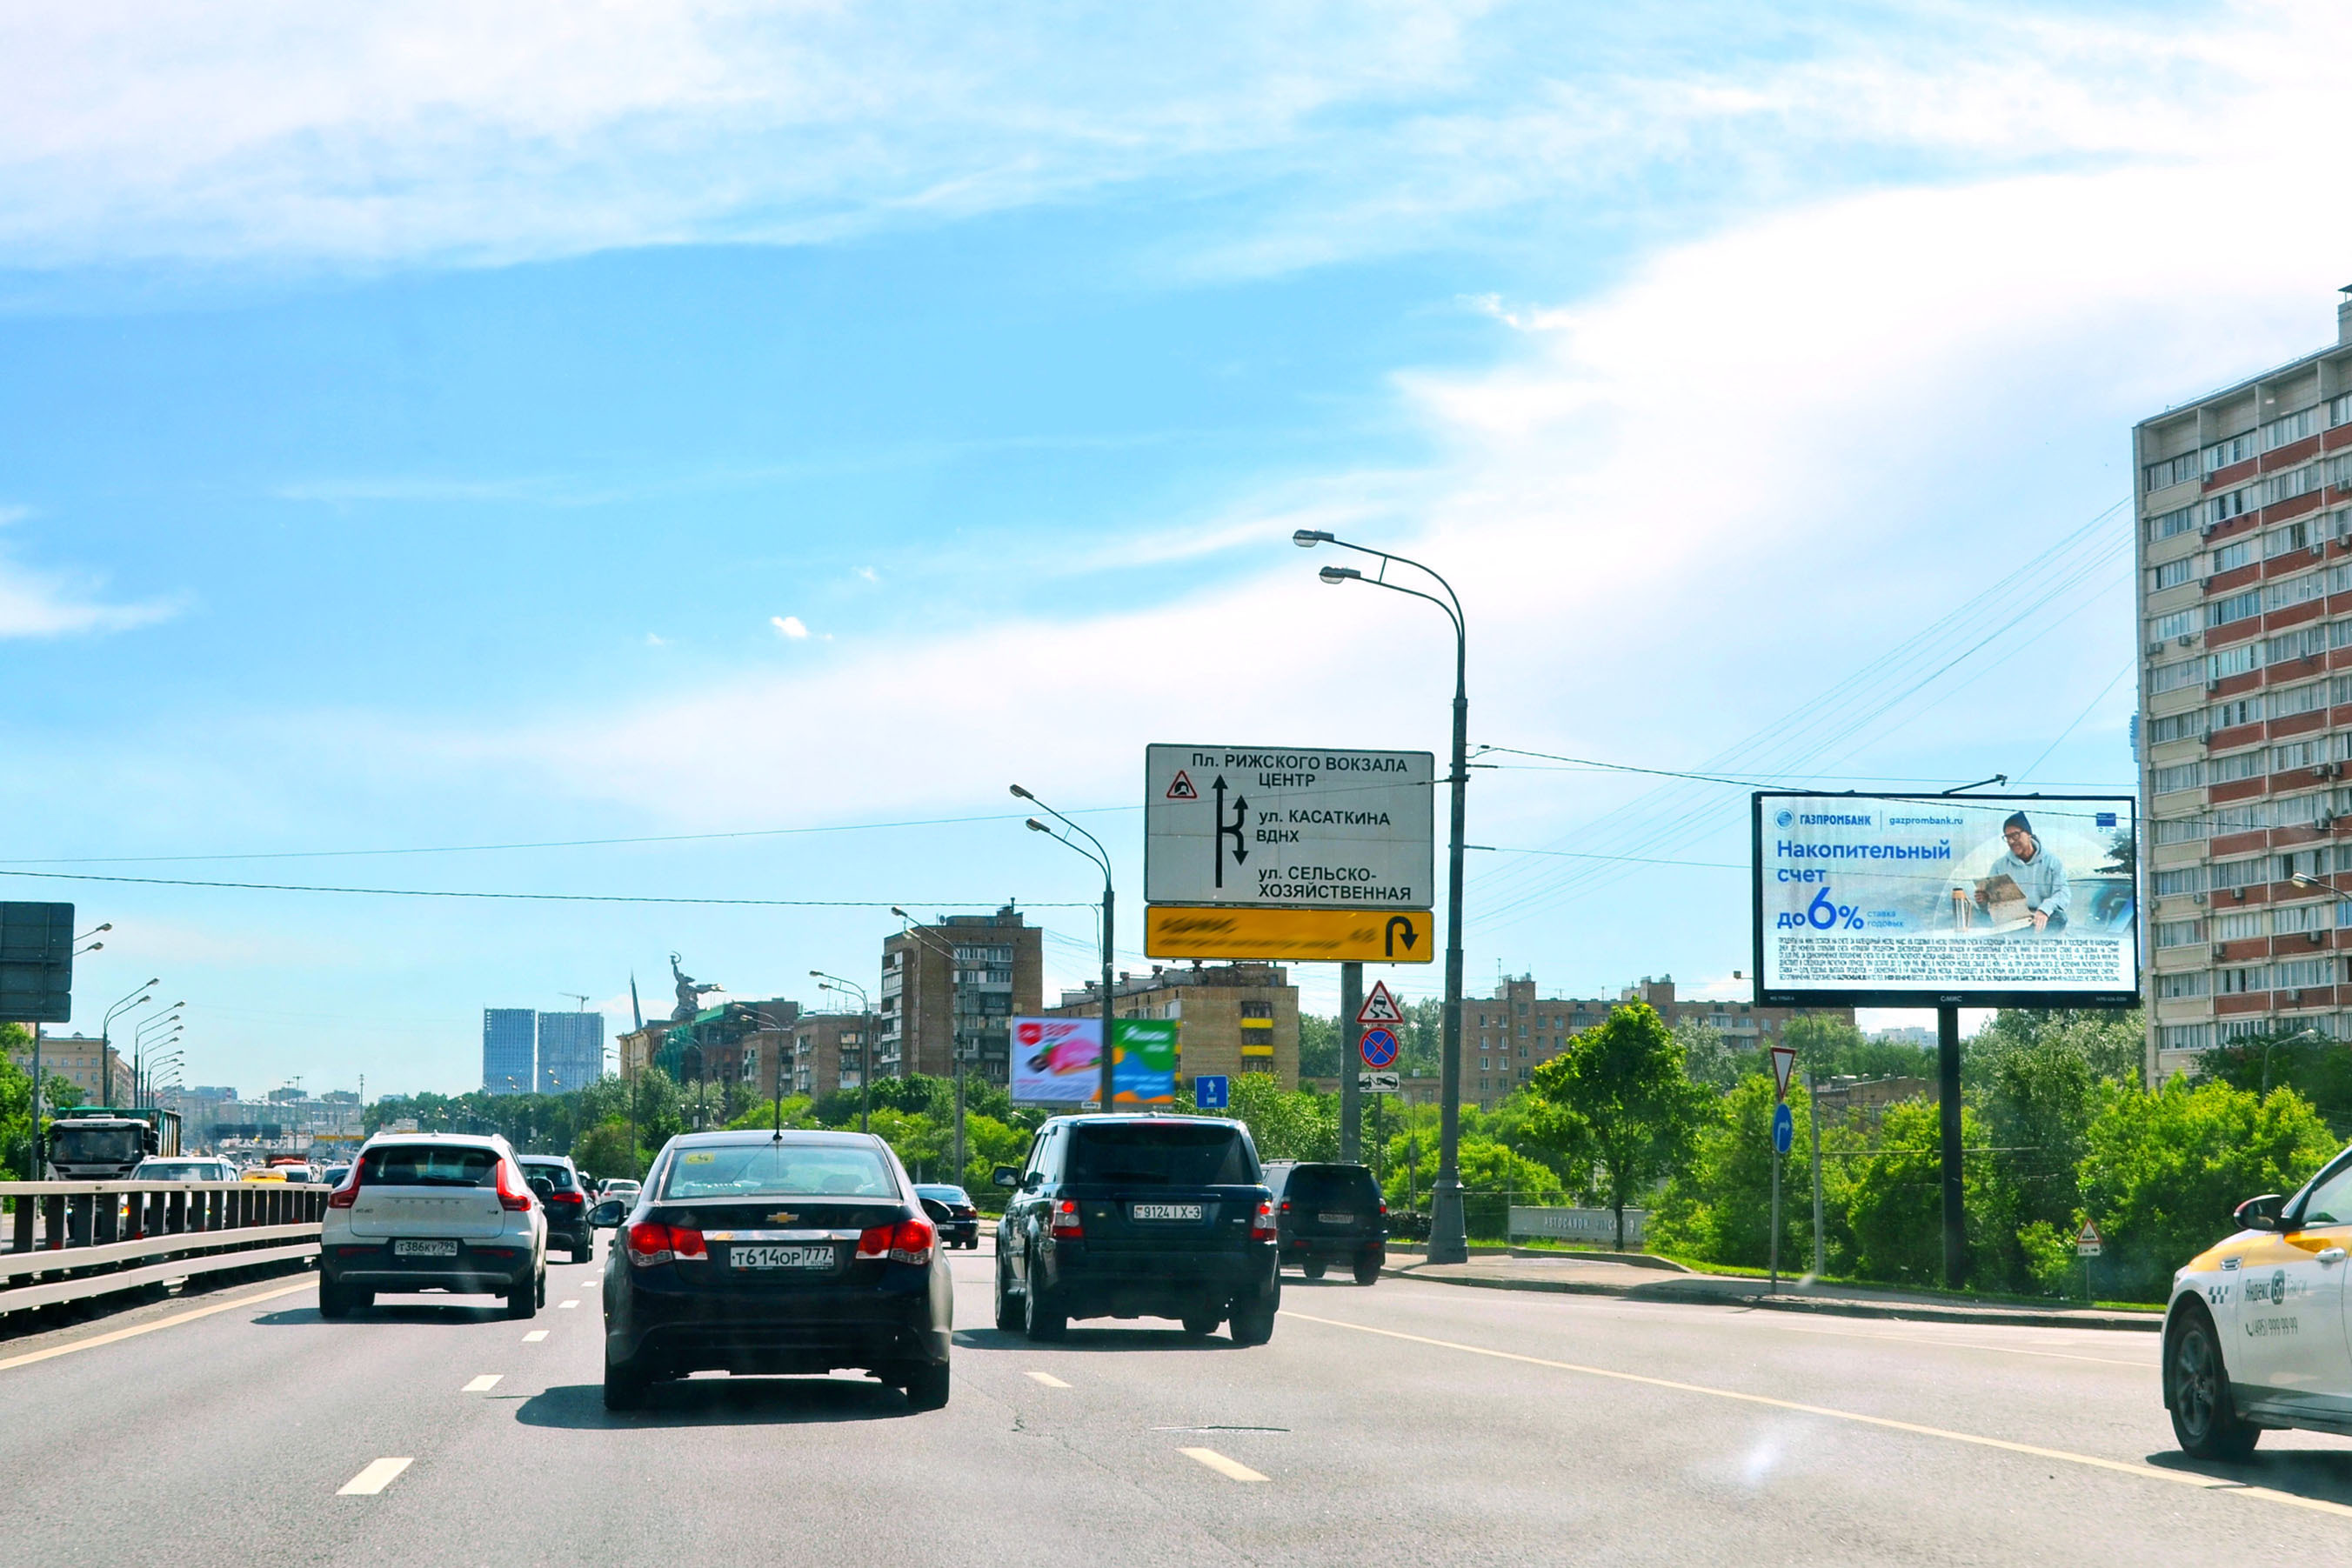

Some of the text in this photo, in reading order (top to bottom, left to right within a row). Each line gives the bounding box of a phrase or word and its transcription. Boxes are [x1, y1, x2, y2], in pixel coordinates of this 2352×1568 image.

[1192, 753, 1407, 772] Пл. РИЖСКОГО ВОКЗАЛА
[1259, 773, 1315, 788] ЦЕНТР
[1259, 811, 1391, 825] ул. КАСАТКИНА
[1800, 814, 1872, 825] ГАЗПРОМБАНК
[1889, 816, 1963, 826] gazprombank.ru
[1256, 830, 1300, 844] ВДНХ
[1777, 839, 1951, 859] Накопительный
[1259, 866, 1376, 882] ул. СЕЛЬСКО-
[1777, 869, 1826, 883] счет
[1259, 881, 1412, 900] ХОЗЯЙСТВЕННАЯ
[1777, 886, 1864, 930] до 6%
[1144, 1206, 1169, 1218] 9124
[2245, 1278, 2270, 1303] Яндекс
